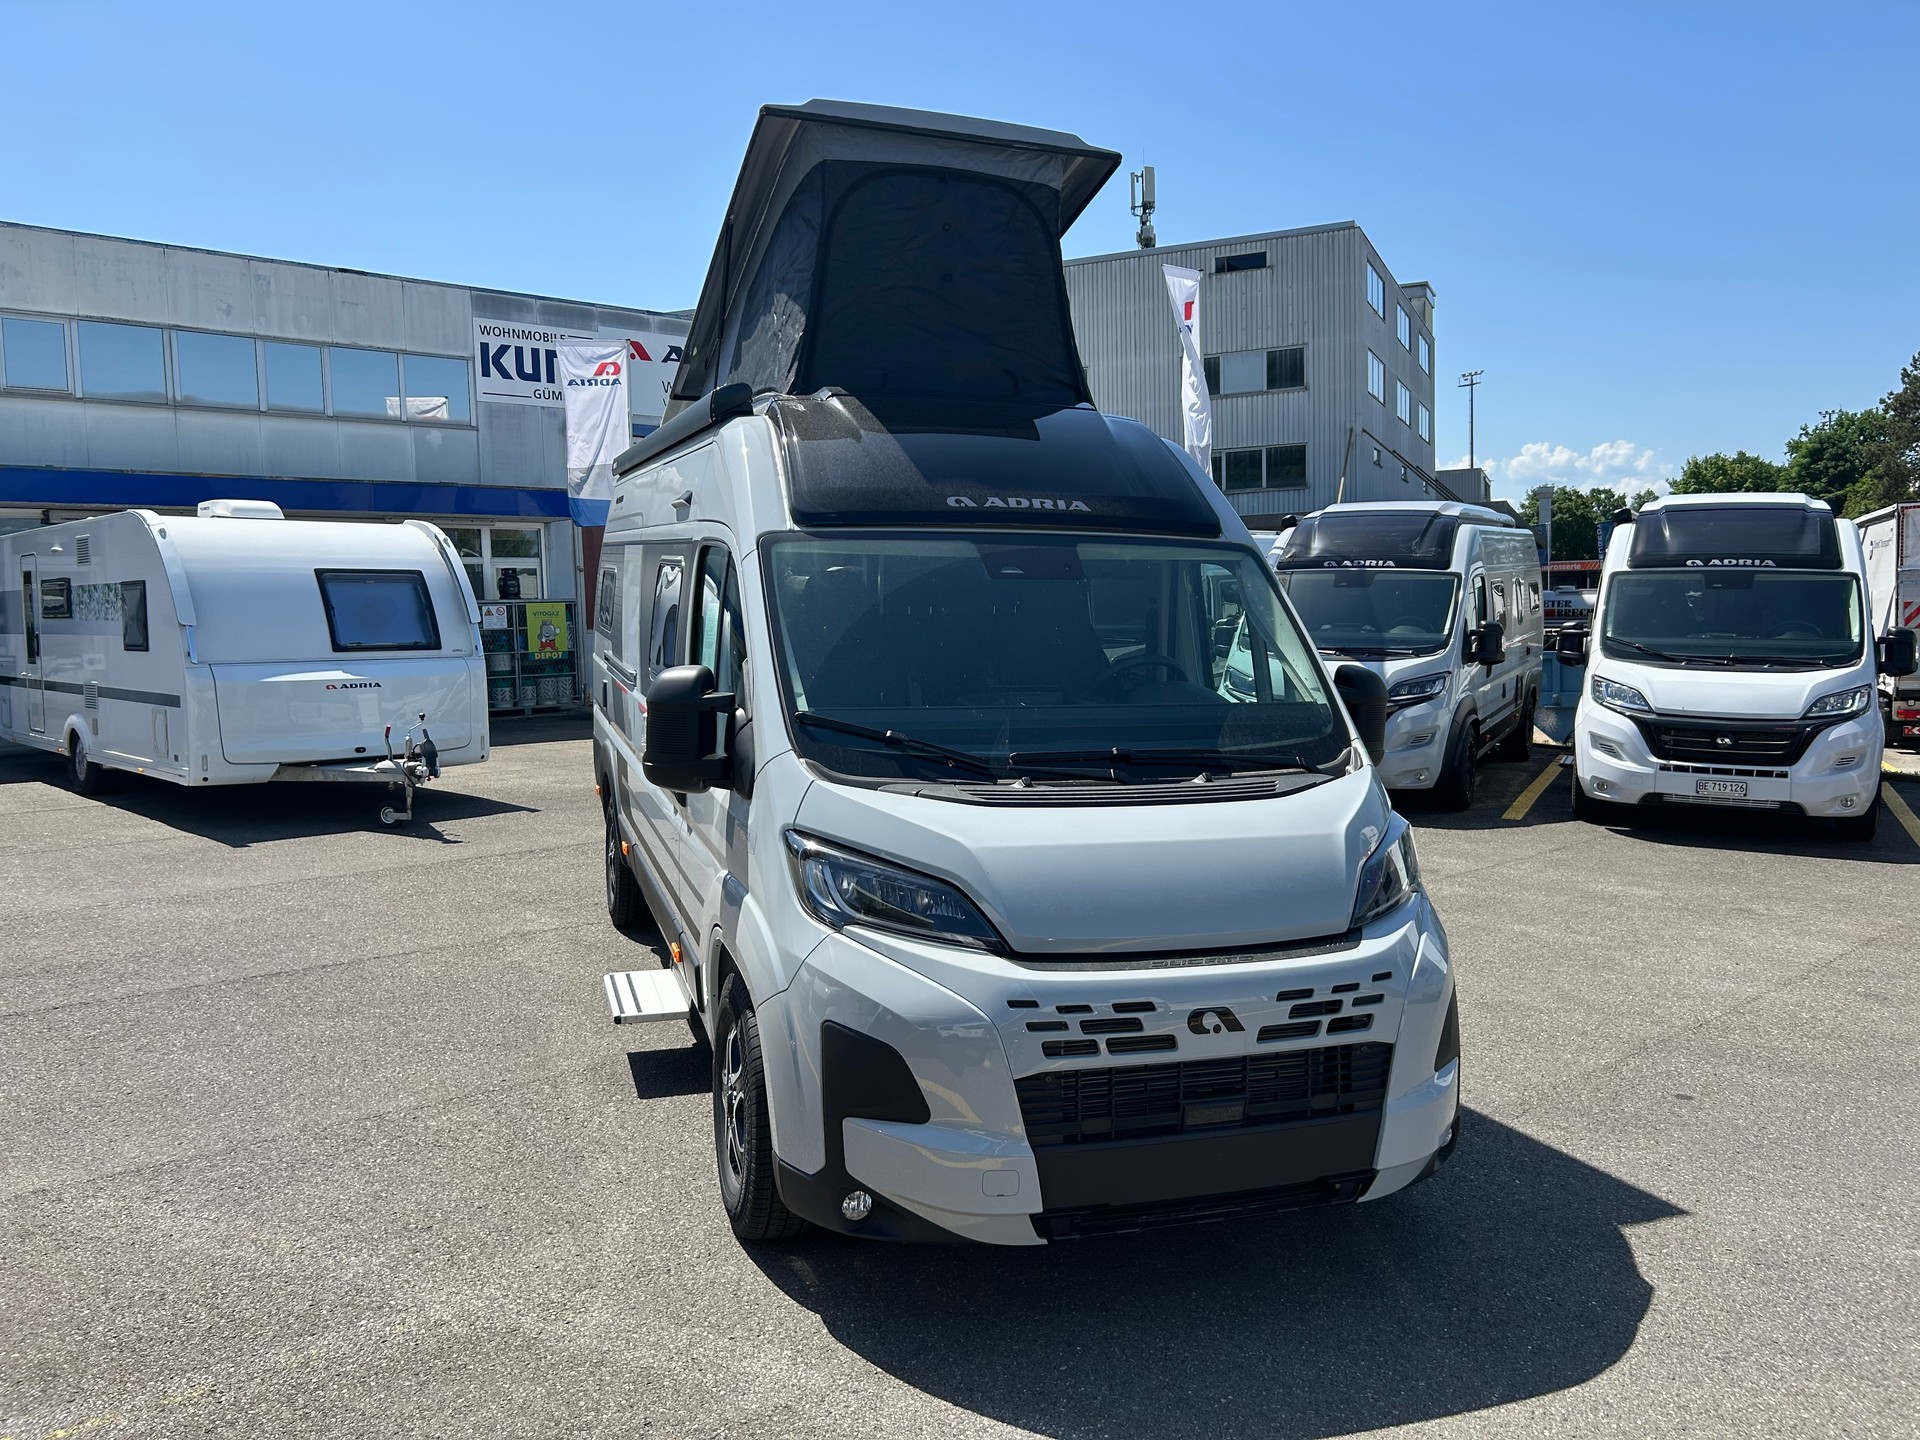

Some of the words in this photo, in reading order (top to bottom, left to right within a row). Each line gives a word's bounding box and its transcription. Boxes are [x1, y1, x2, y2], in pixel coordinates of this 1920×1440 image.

[479, 325, 566, 342] WOHNMOBILE
[480, 342, 558, 384] KUN
[533, 388, 563, 400] GÜM
[984, 497, 1092, 512] ADRIA
[1541, 563, 1581, 572] arrosserie
[1708, 559, 1777, 567] ADRIA
[1544, 600, 1572, 608] ETER
[1556, 608, 1594, 617] BRECH
[535, 651, 563, 660] DEPOT
[340, 682, 382, 690] ADRIA
[1729, 783, 1745, 792] 126
